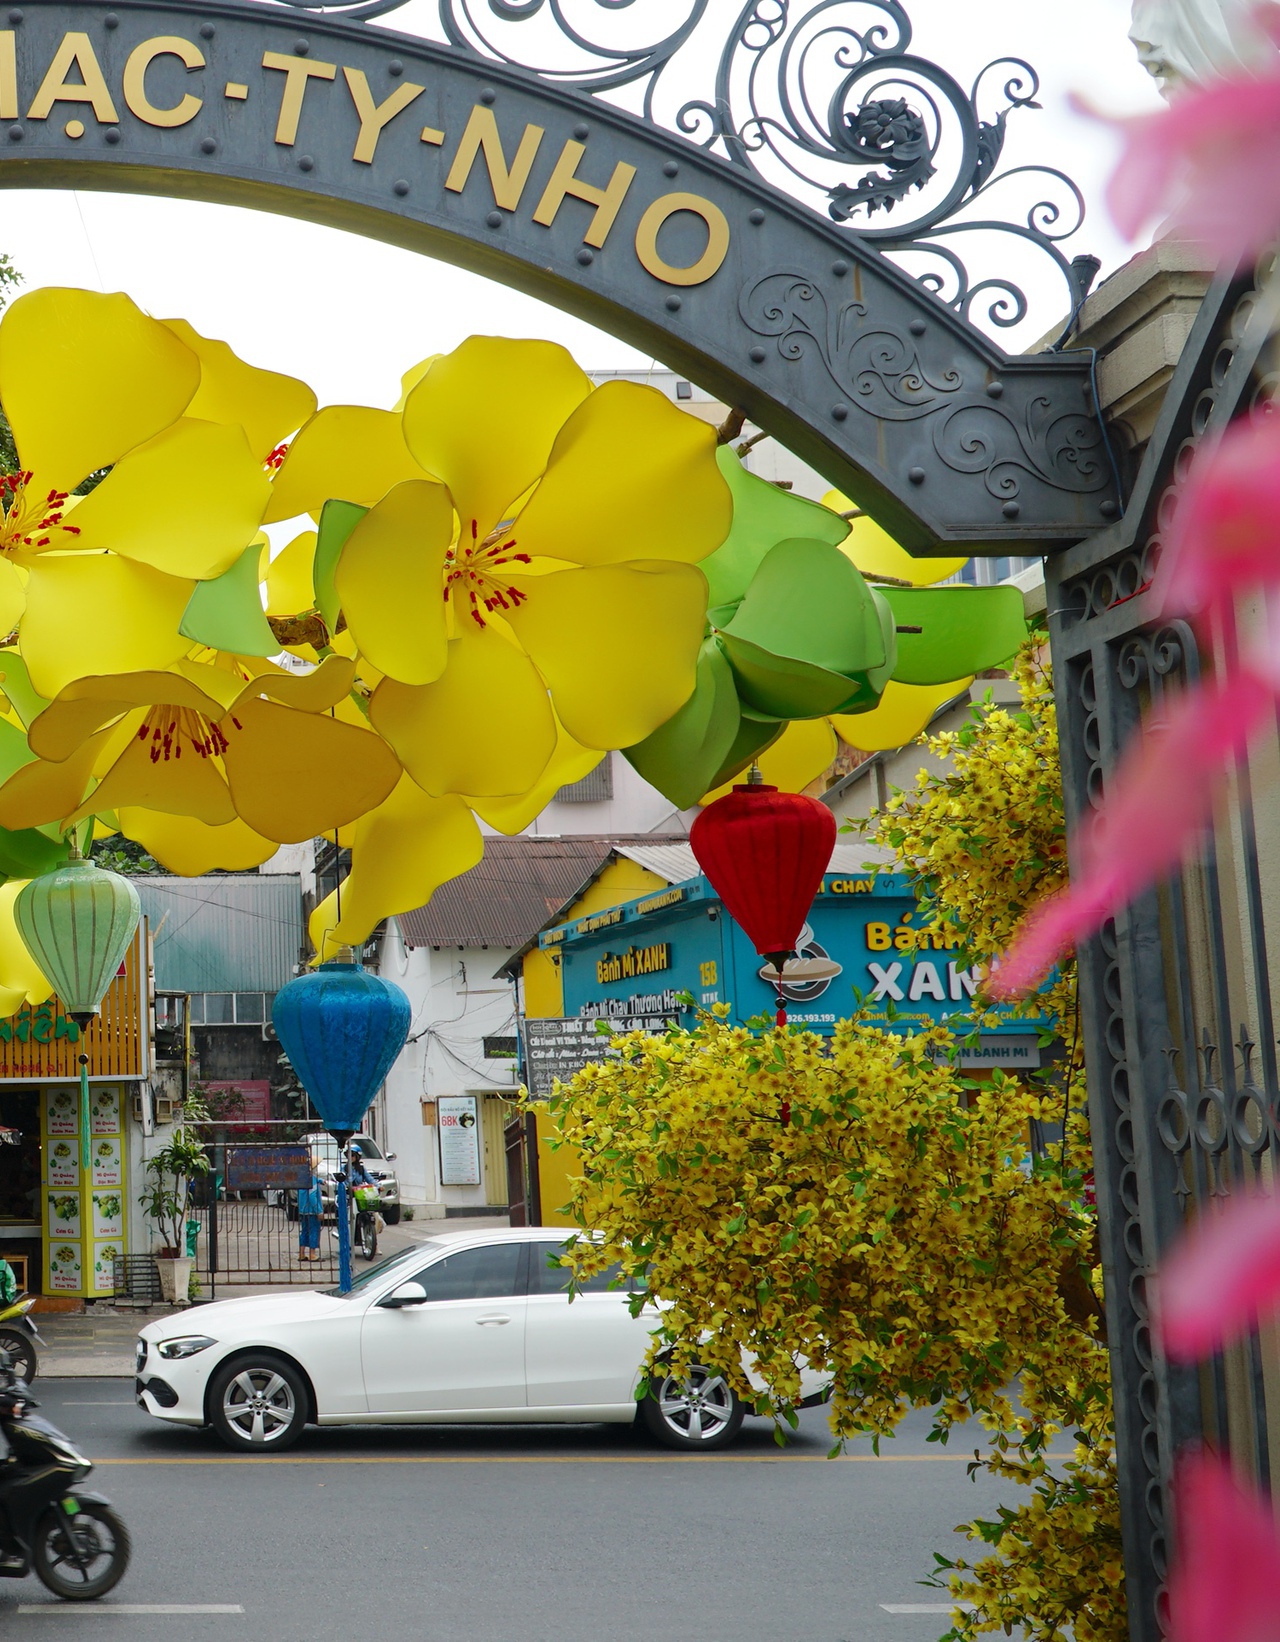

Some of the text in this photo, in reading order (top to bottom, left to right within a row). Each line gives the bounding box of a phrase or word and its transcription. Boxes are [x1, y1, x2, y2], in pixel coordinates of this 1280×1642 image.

[831, 879, 875, 894] CHAY
[867, 912, 960, 951] Bán
[597, 952, 620, 984] Bánh
[636, 943, 667, 975] XANH
[699, 961, 717, 986] 15B
[868, 961, 1000, 1001] XAN
[786, 1014, 835, 1022] 926.193.193
[1000, 1012, 1023, 1020] CHY
[441, 1115, 458, 1127] 68K
